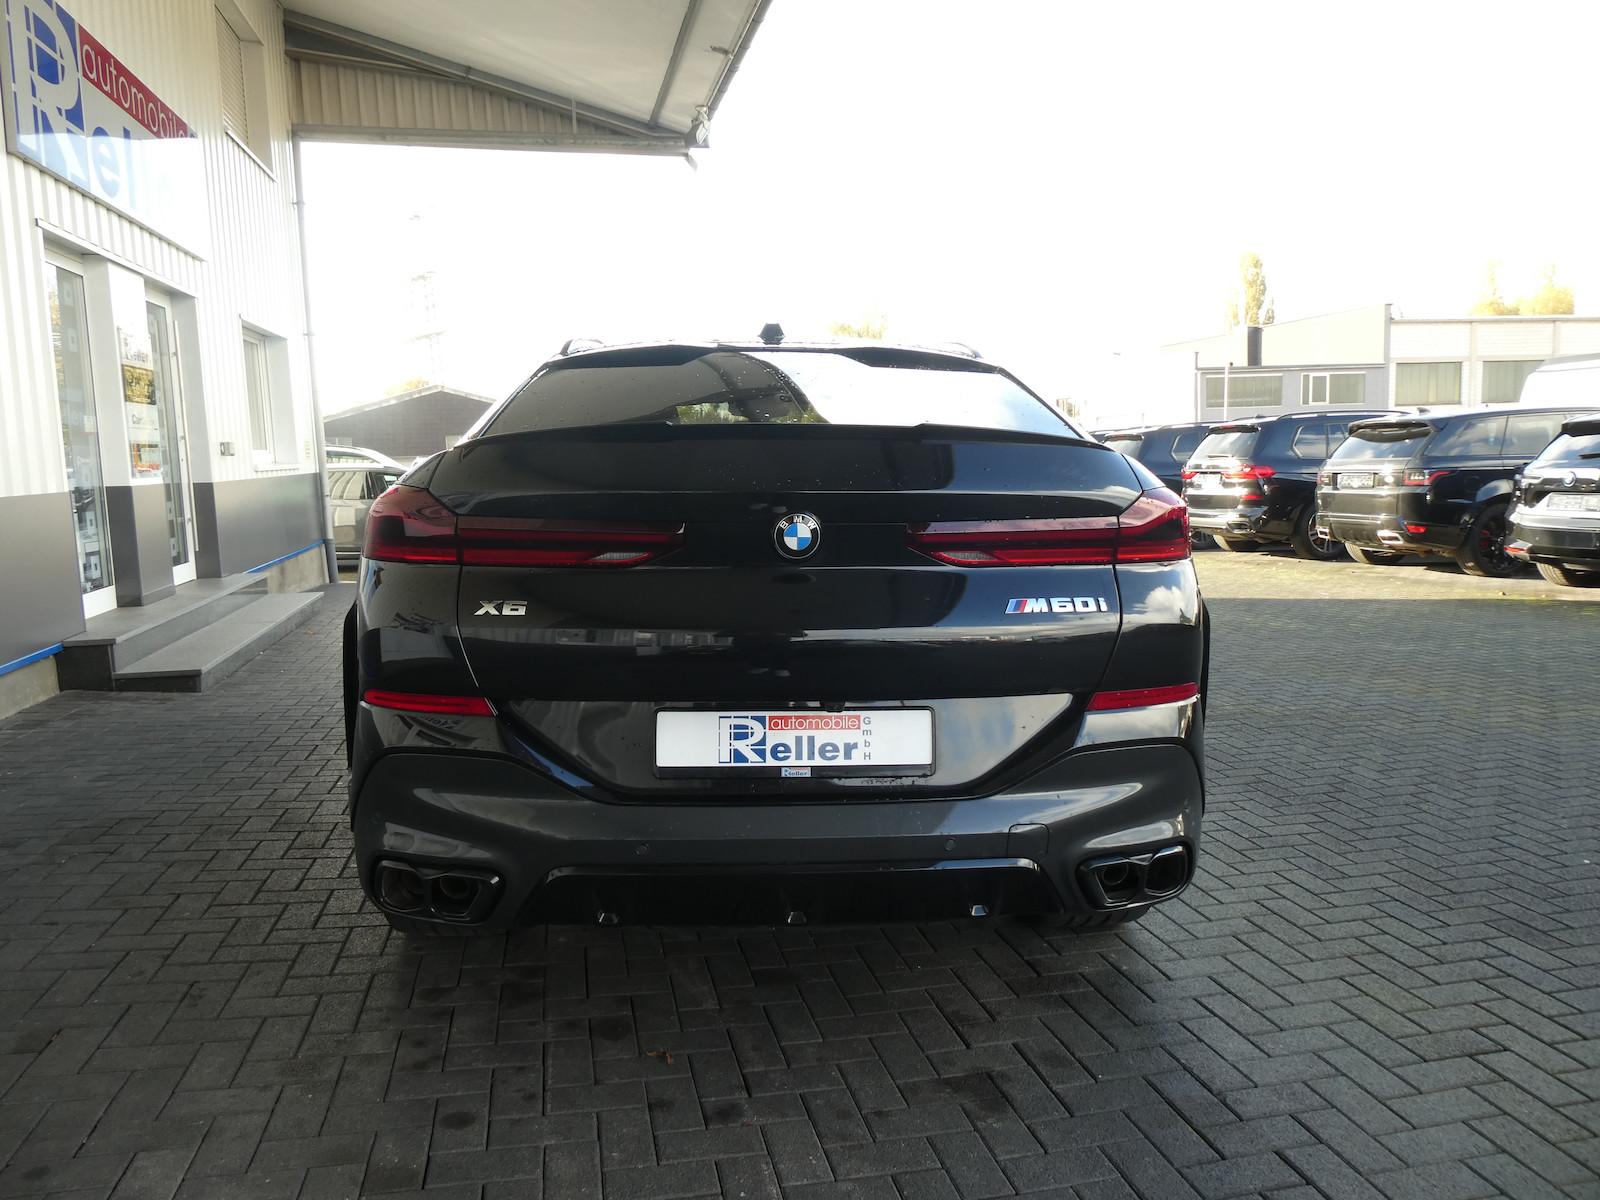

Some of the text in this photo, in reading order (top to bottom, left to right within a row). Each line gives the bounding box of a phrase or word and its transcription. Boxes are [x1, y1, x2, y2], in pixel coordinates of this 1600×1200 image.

[780, 515, 817, 530] BMW
[473, 600, 528, 616] X6
[1023, 597, 1108, 614] M60i
[770, 716, 859, 730] automobile
